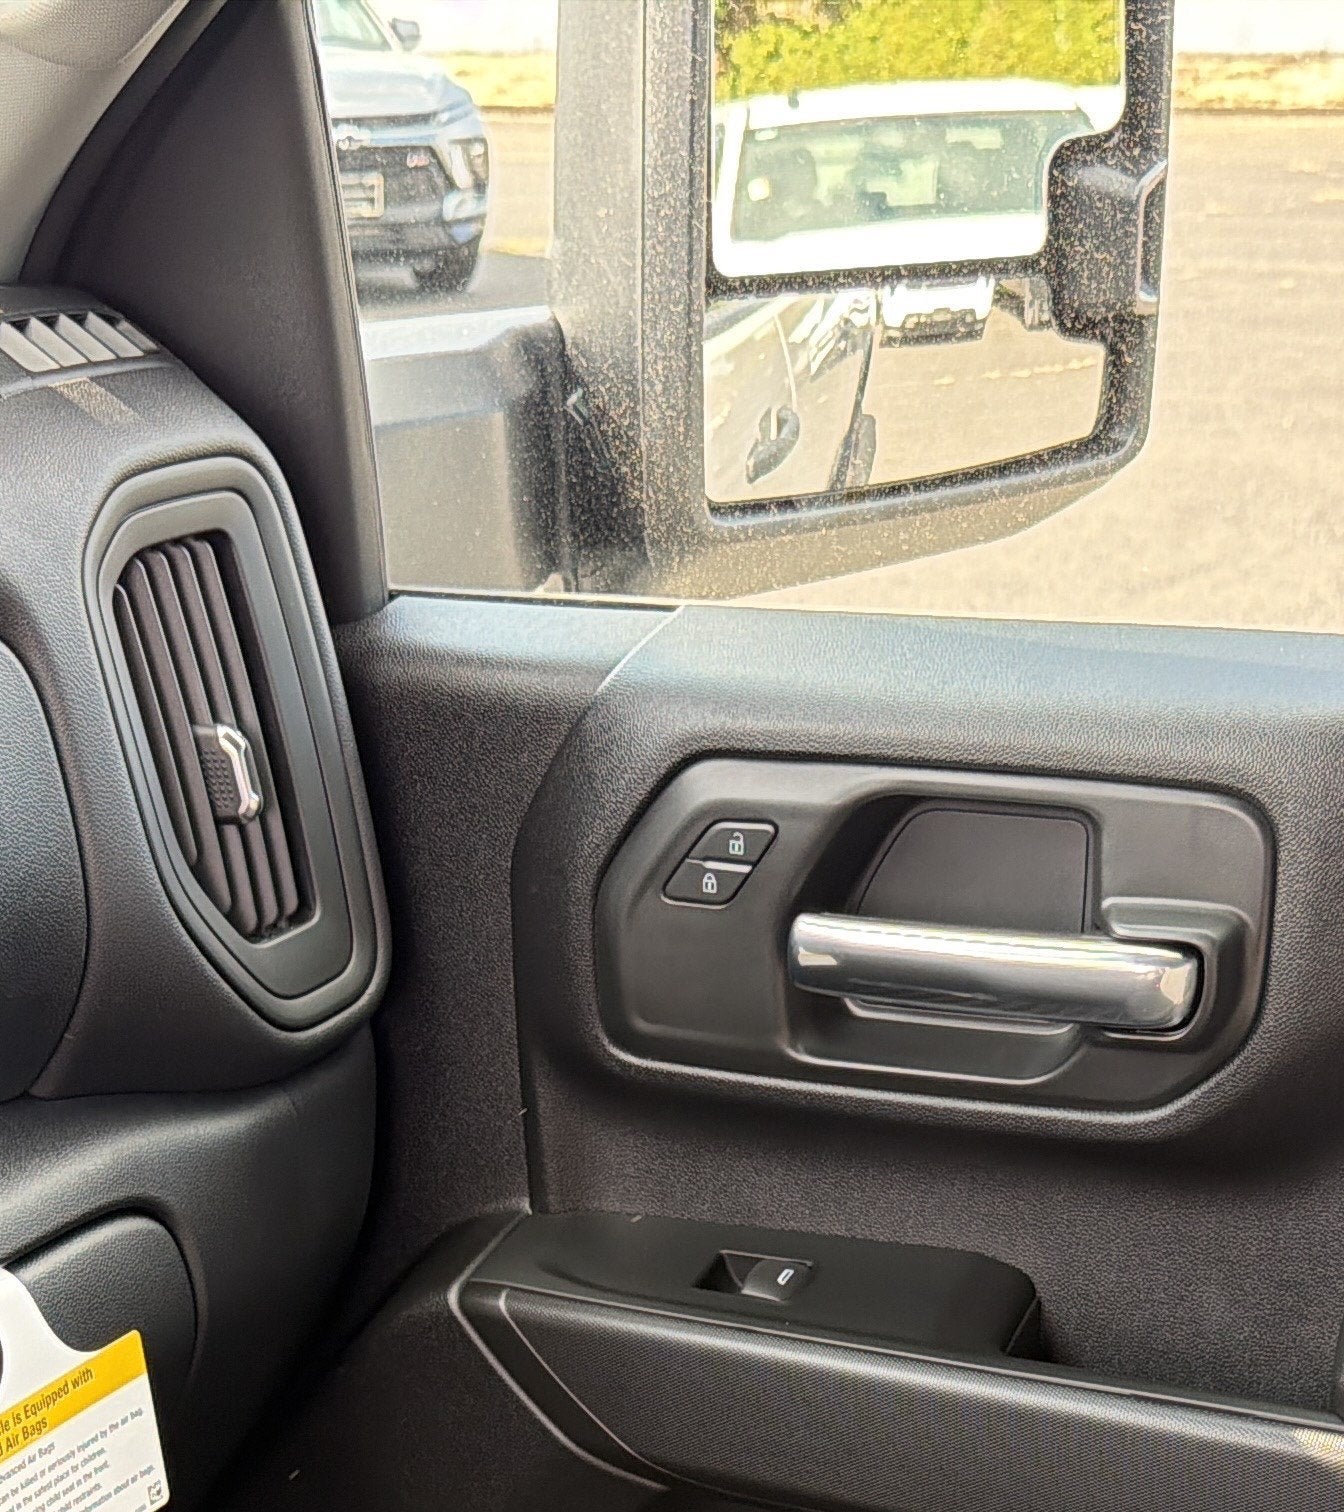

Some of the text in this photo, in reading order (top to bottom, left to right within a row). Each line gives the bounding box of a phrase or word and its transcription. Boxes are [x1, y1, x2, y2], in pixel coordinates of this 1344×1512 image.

[23, 1379, 70, 1420] Equipped
[70, 1367, 94, 1390] with
[5, 1433, 20, 1453] Air
[21, 1416, 48, 1442] Bags
